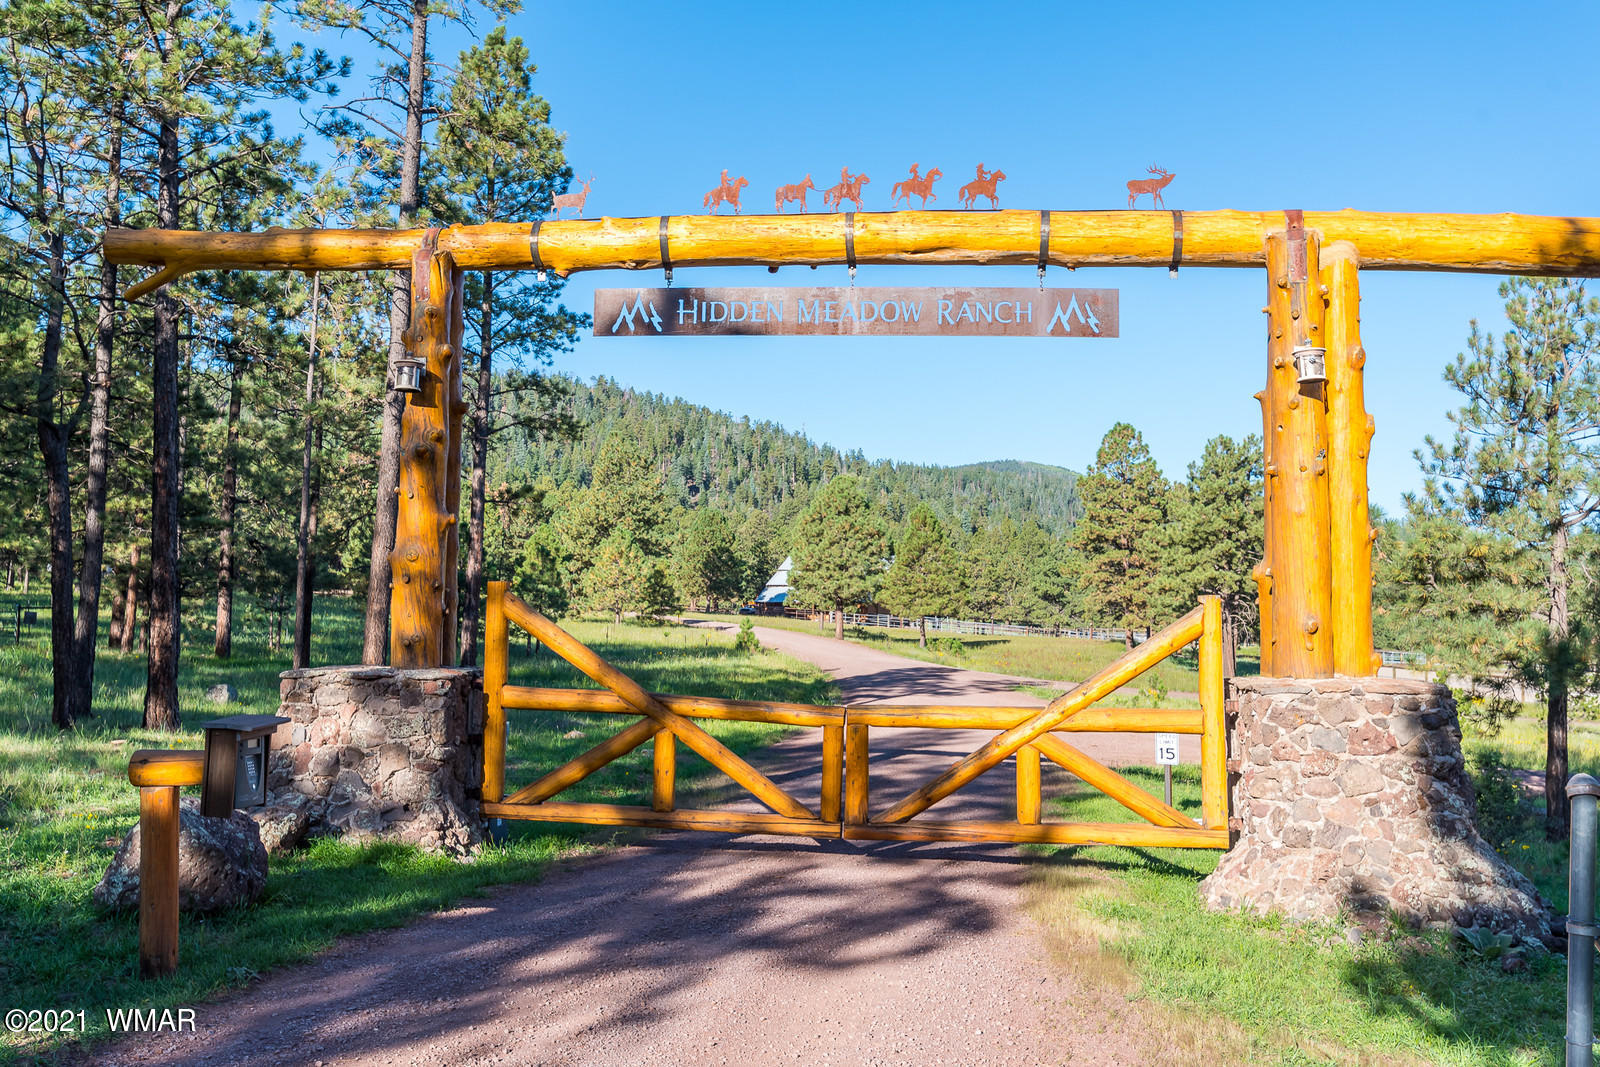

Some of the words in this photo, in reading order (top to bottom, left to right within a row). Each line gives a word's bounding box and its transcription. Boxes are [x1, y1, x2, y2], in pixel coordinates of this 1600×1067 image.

[676, 298, 784, 325] HIDDEN
[797, 298, 924, 326] MEADOW
[937, 299, 1033, 326] RANCH
[1159, 747, 1176, 760] 15
